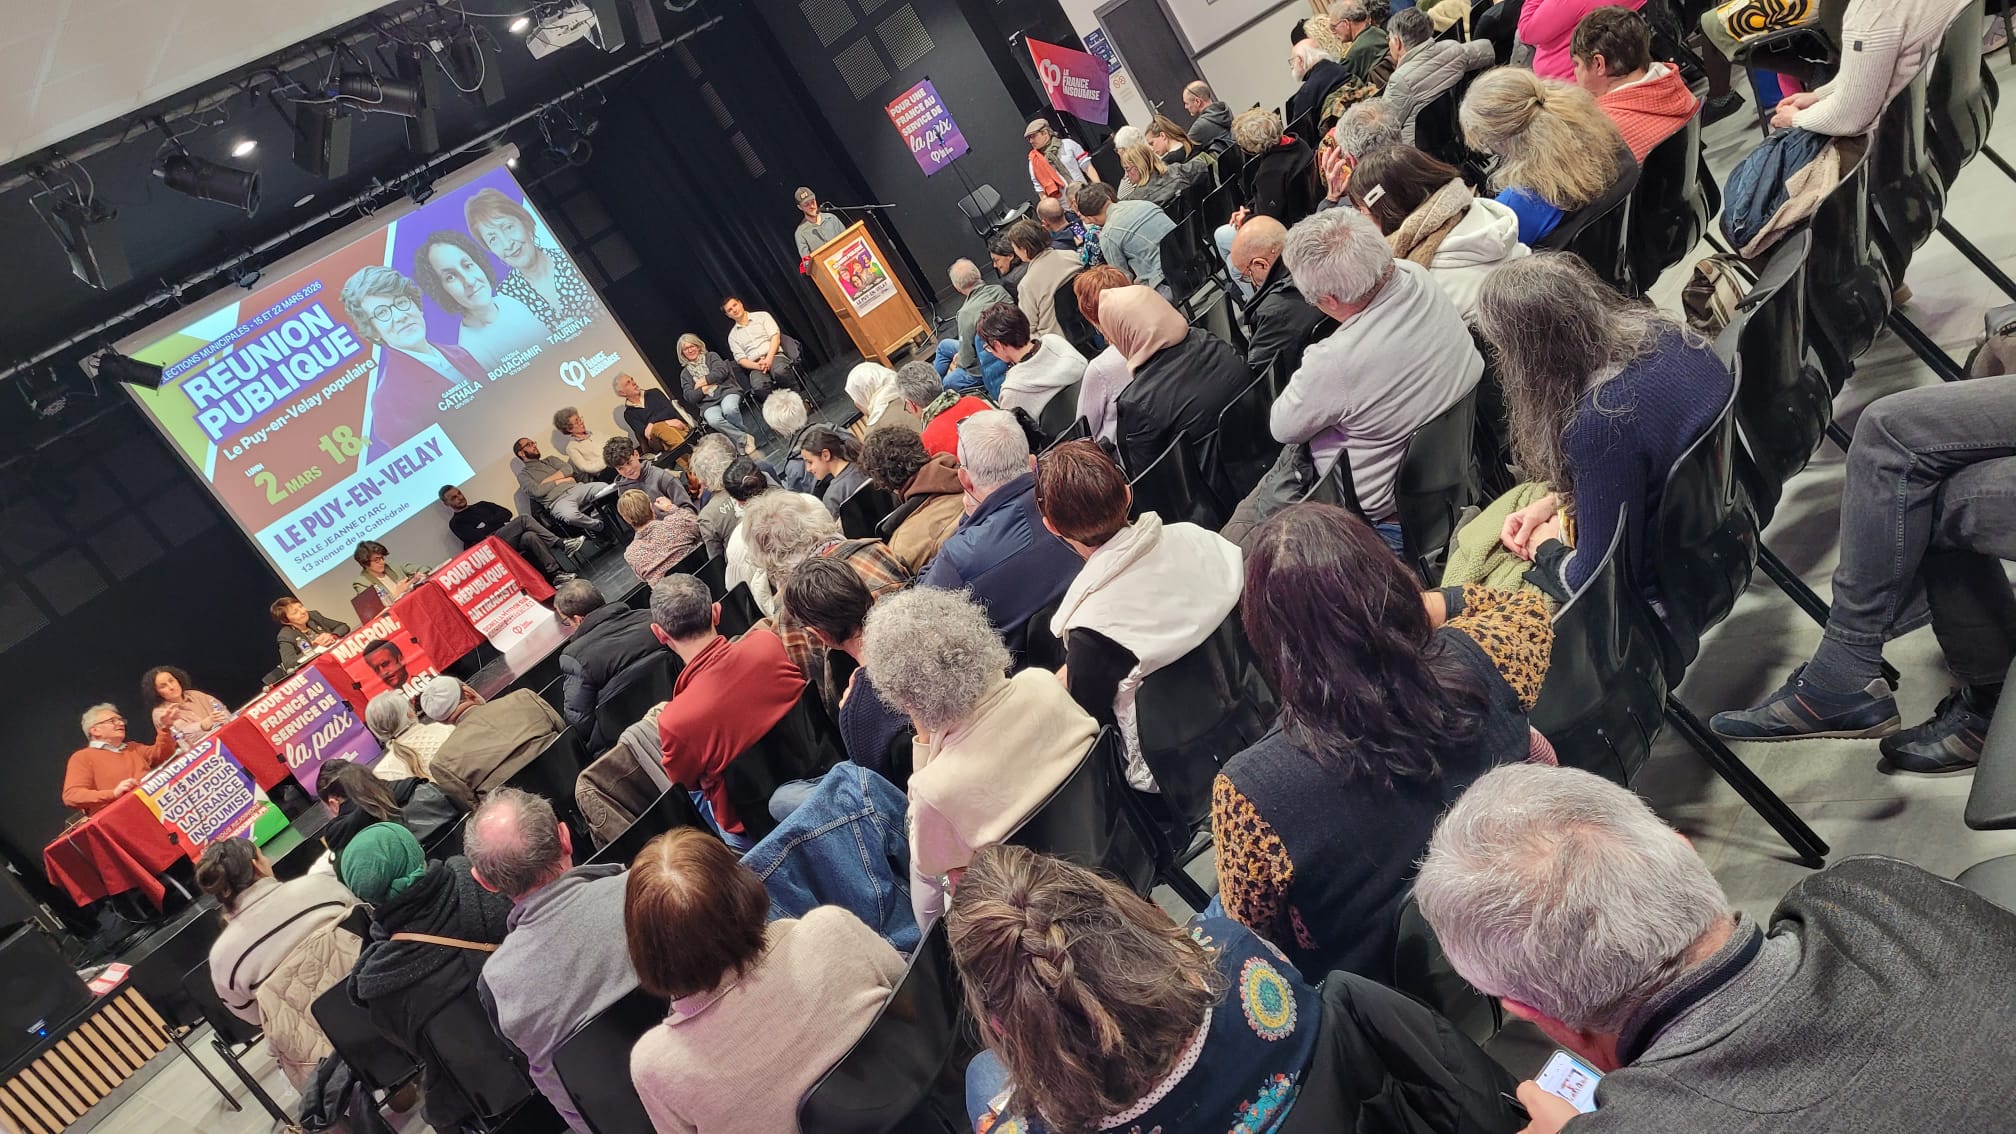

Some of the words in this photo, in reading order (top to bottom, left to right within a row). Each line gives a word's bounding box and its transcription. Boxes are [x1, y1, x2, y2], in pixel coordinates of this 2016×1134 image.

[889, 98, 912, 117] POUR
[909, 87, 927, 103] UNE
[1062, 76, 1090, 89] FRANCE
[1062, 85, 1101, 101] INSOUMISE
[895, 102, 926, 127] FRANCE
[923, 95, 936, 109] AU
[901, 113, 934, 137] SERVICE
[930, 104, 944, 117] DE
[909, 134, 926, 153] la
[162, 354, 201, 383] LECTIONS
[200, 324, 251, 358] MUNICIPALES
[253, 313, 264, 326] 15
[261, 308, 274, 321] ET
[270, 303, 283, 316] 22
[280, 291, 305, 312] MARS
[302, 280, 323, 301] 2026
[546, 315, 593, 346] TAURINYA
[183, 303, 335, 411] RÉUNION
[487, 344, 543, 382] BOUACHMIR
[197, 325, 361, 441] PUBLIQUE
[437, 380, 484, 412] CATHALA
[222, 440, 243, 461] Le
[239, 390, 323, 449] Puy-en-Velay
[322, 358, 375, 401] populaire
[254, 471, 289, 506] 2
[284, 465, 323, 494] MARS
[273, 524, 307, 554] LE
[299, 436, 444, 537] PUY-EN-VELAY
[293, 543, 324, 564] SALLE
[323, 519, 362, 549] JEANNE
[358, 502, 388, 524] D'ARC
[300, 561, 314, 574] 13
[313, 544, 345, 568] avenue
[345, 534, 357, 547] de
[355, 529, 367, 542] la
[363, 501, 411, 535] Cathédrale
[438, 560, 476, 591] POUR
[467, 544, 497, 570] UNE
[451, 562, 509, 607] RÉPUBLIQUE
[467, 578, 519, 622] ANTIRACISTE
[330, 615, 402, 664] MACRON,
[247, 692, 284, 720] POUR
[281, 674, 309, 696] UNE
[260, 695, 309, 733] FRANCE
[304, 681, 326, 702] AU
[271, 709, 323, 747] SERVICE
[319, 694, 338, 713] DE
[285, 742, 313, 769] la
[311, 710, 353, 761] paix
[142, 740, 213, 796] MUNICIPALES
[157, 792, 174, 809] LE
[173, 781, 188, 797] 15
[185, 755, 226, 787] MARS,
[165, 788, 205, 822] VOTEZ
[203, 763, 237, 791] POUR
[180, 812, 199, 831] LA
[196, 777, 242, 818] FRANCE
[190, 789, 251, 843] INSOUMISE
